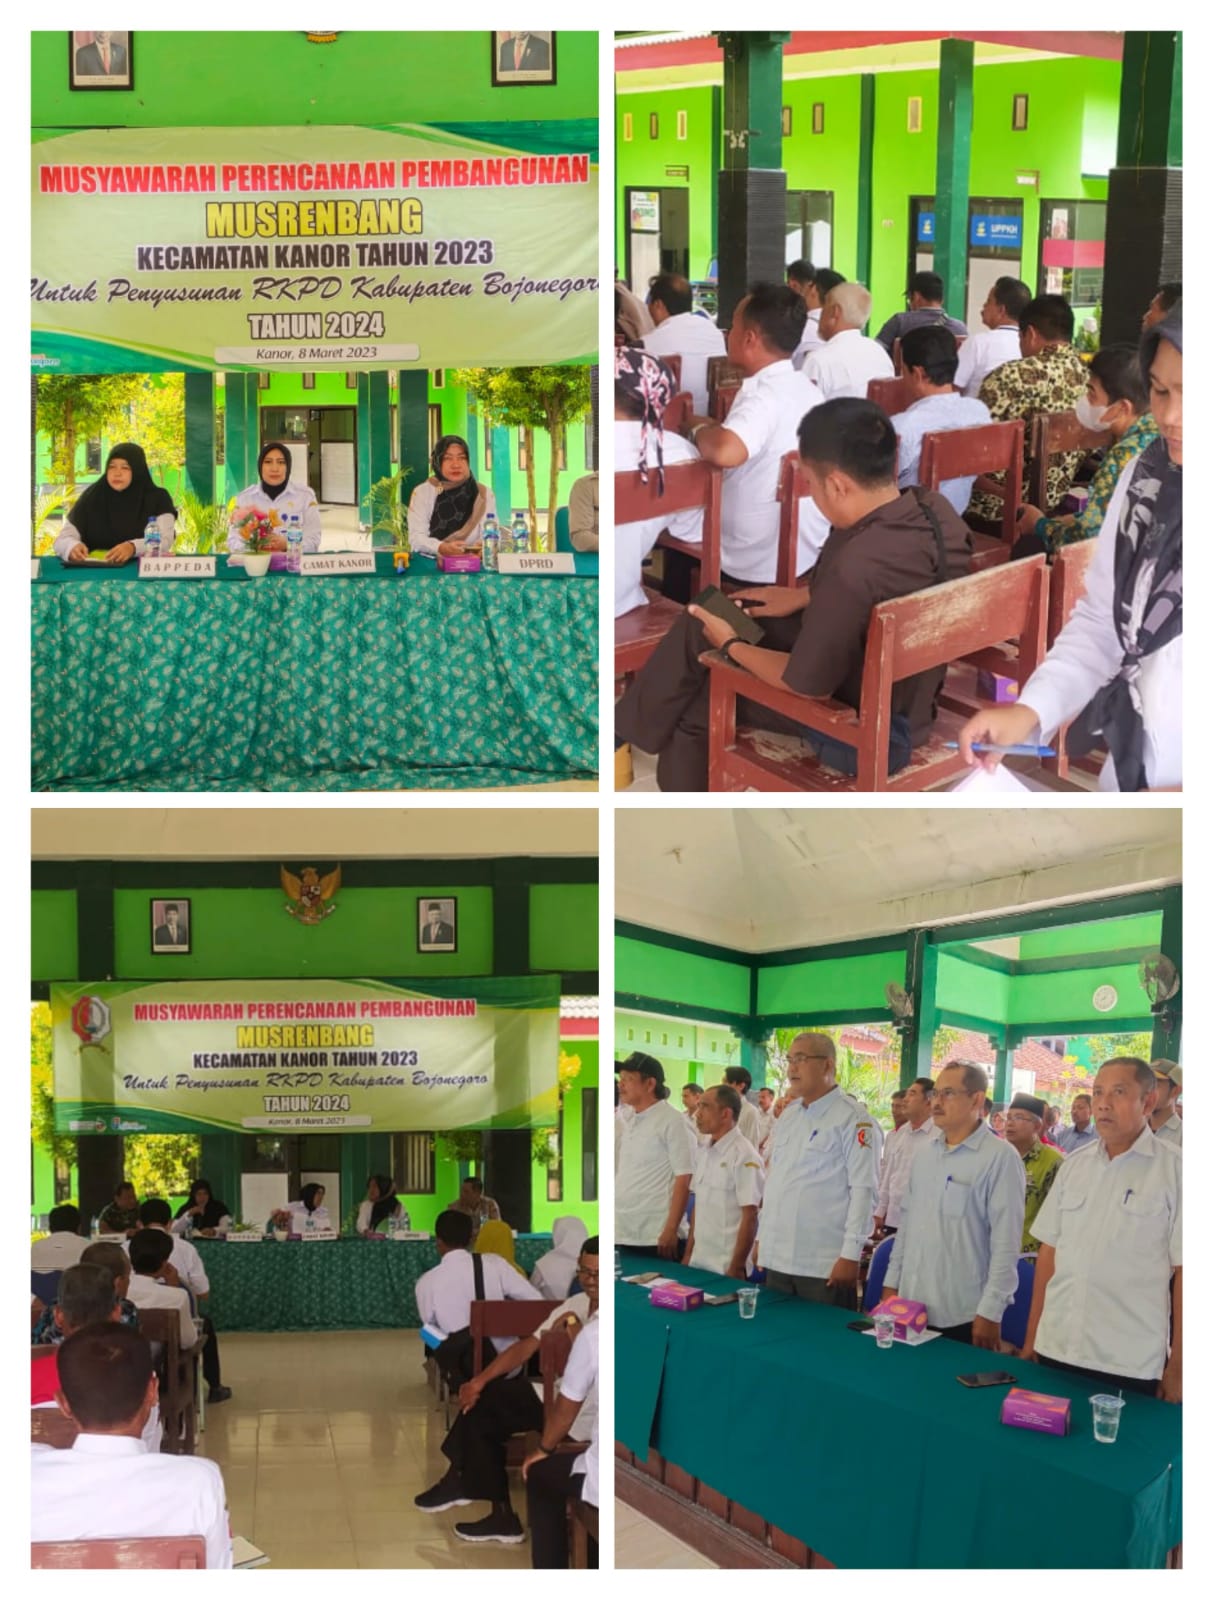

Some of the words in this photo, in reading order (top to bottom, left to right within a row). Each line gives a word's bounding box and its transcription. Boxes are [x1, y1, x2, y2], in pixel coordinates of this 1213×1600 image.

[40, 165, 216, 193] MUSYAWARAH
[222, 161, 395, 192] PERENCANAAN
[401, 155, 589, 188] PEMBANGUNAN
[206, 198, 423, 238] MUSRENBANG
[137, 245, 269, 270] KECAMATAN
[274, 243, 350, 268] KANOR
[356, 242, 428, 266] TAHUN
[434, 240, 493, 265] 2023
[31, 277, 97, 301] Untuk
[107, 278, 242, 308] Penyusunan
[252, 276, 342, 301] RKPD
[351, 274, 473, 303] Kabupaten
[483, 271, 599, 303] Bojonegor
[247, 313, 322, 340] TAHUN
[325, 311, 385, 338] 2024
[256, 348, 295, 361] Kanor,
[299, 348, 306, 359] 8
[309, 347, 344, 358] Maret
[346, 347, 377, 358] 2023
[143, 562, 211, 572] BAPPEDA
[303, 560, 335, 570] CAMAT
[338, 558, 372, 569] KANOR
[519, 558, 554, 569] DPRD
[134, 1004, 243, 1021] MUSYAWARAH
[248, 1002, 356, 1020] PERENCANAAN
[361, 999, 476, 1018] PEMBANGUNAN
[237, 1024, 375, 1049] MUSRENBANG
[193, 1053, 276, 1069] KECAMATAN
[281, 1052, 328, 1067] KANOR
[332, 1051, 377, 1066] TAHUN
[381, 1051, 418, 1065] 2023
[123, 1075, 168, 1090] Untuk
[175, 1074, 258, 1092] Penyusunan
[266, 1072, 323, 1088] RKPD
[329, 1072, 404, 1089] Kabupaten
[412, 1071, 488, 1089] Bojonegoro
[263, 1096, 311, 1112] TAHUN
[313, 1095, 350, 1111] 2024
